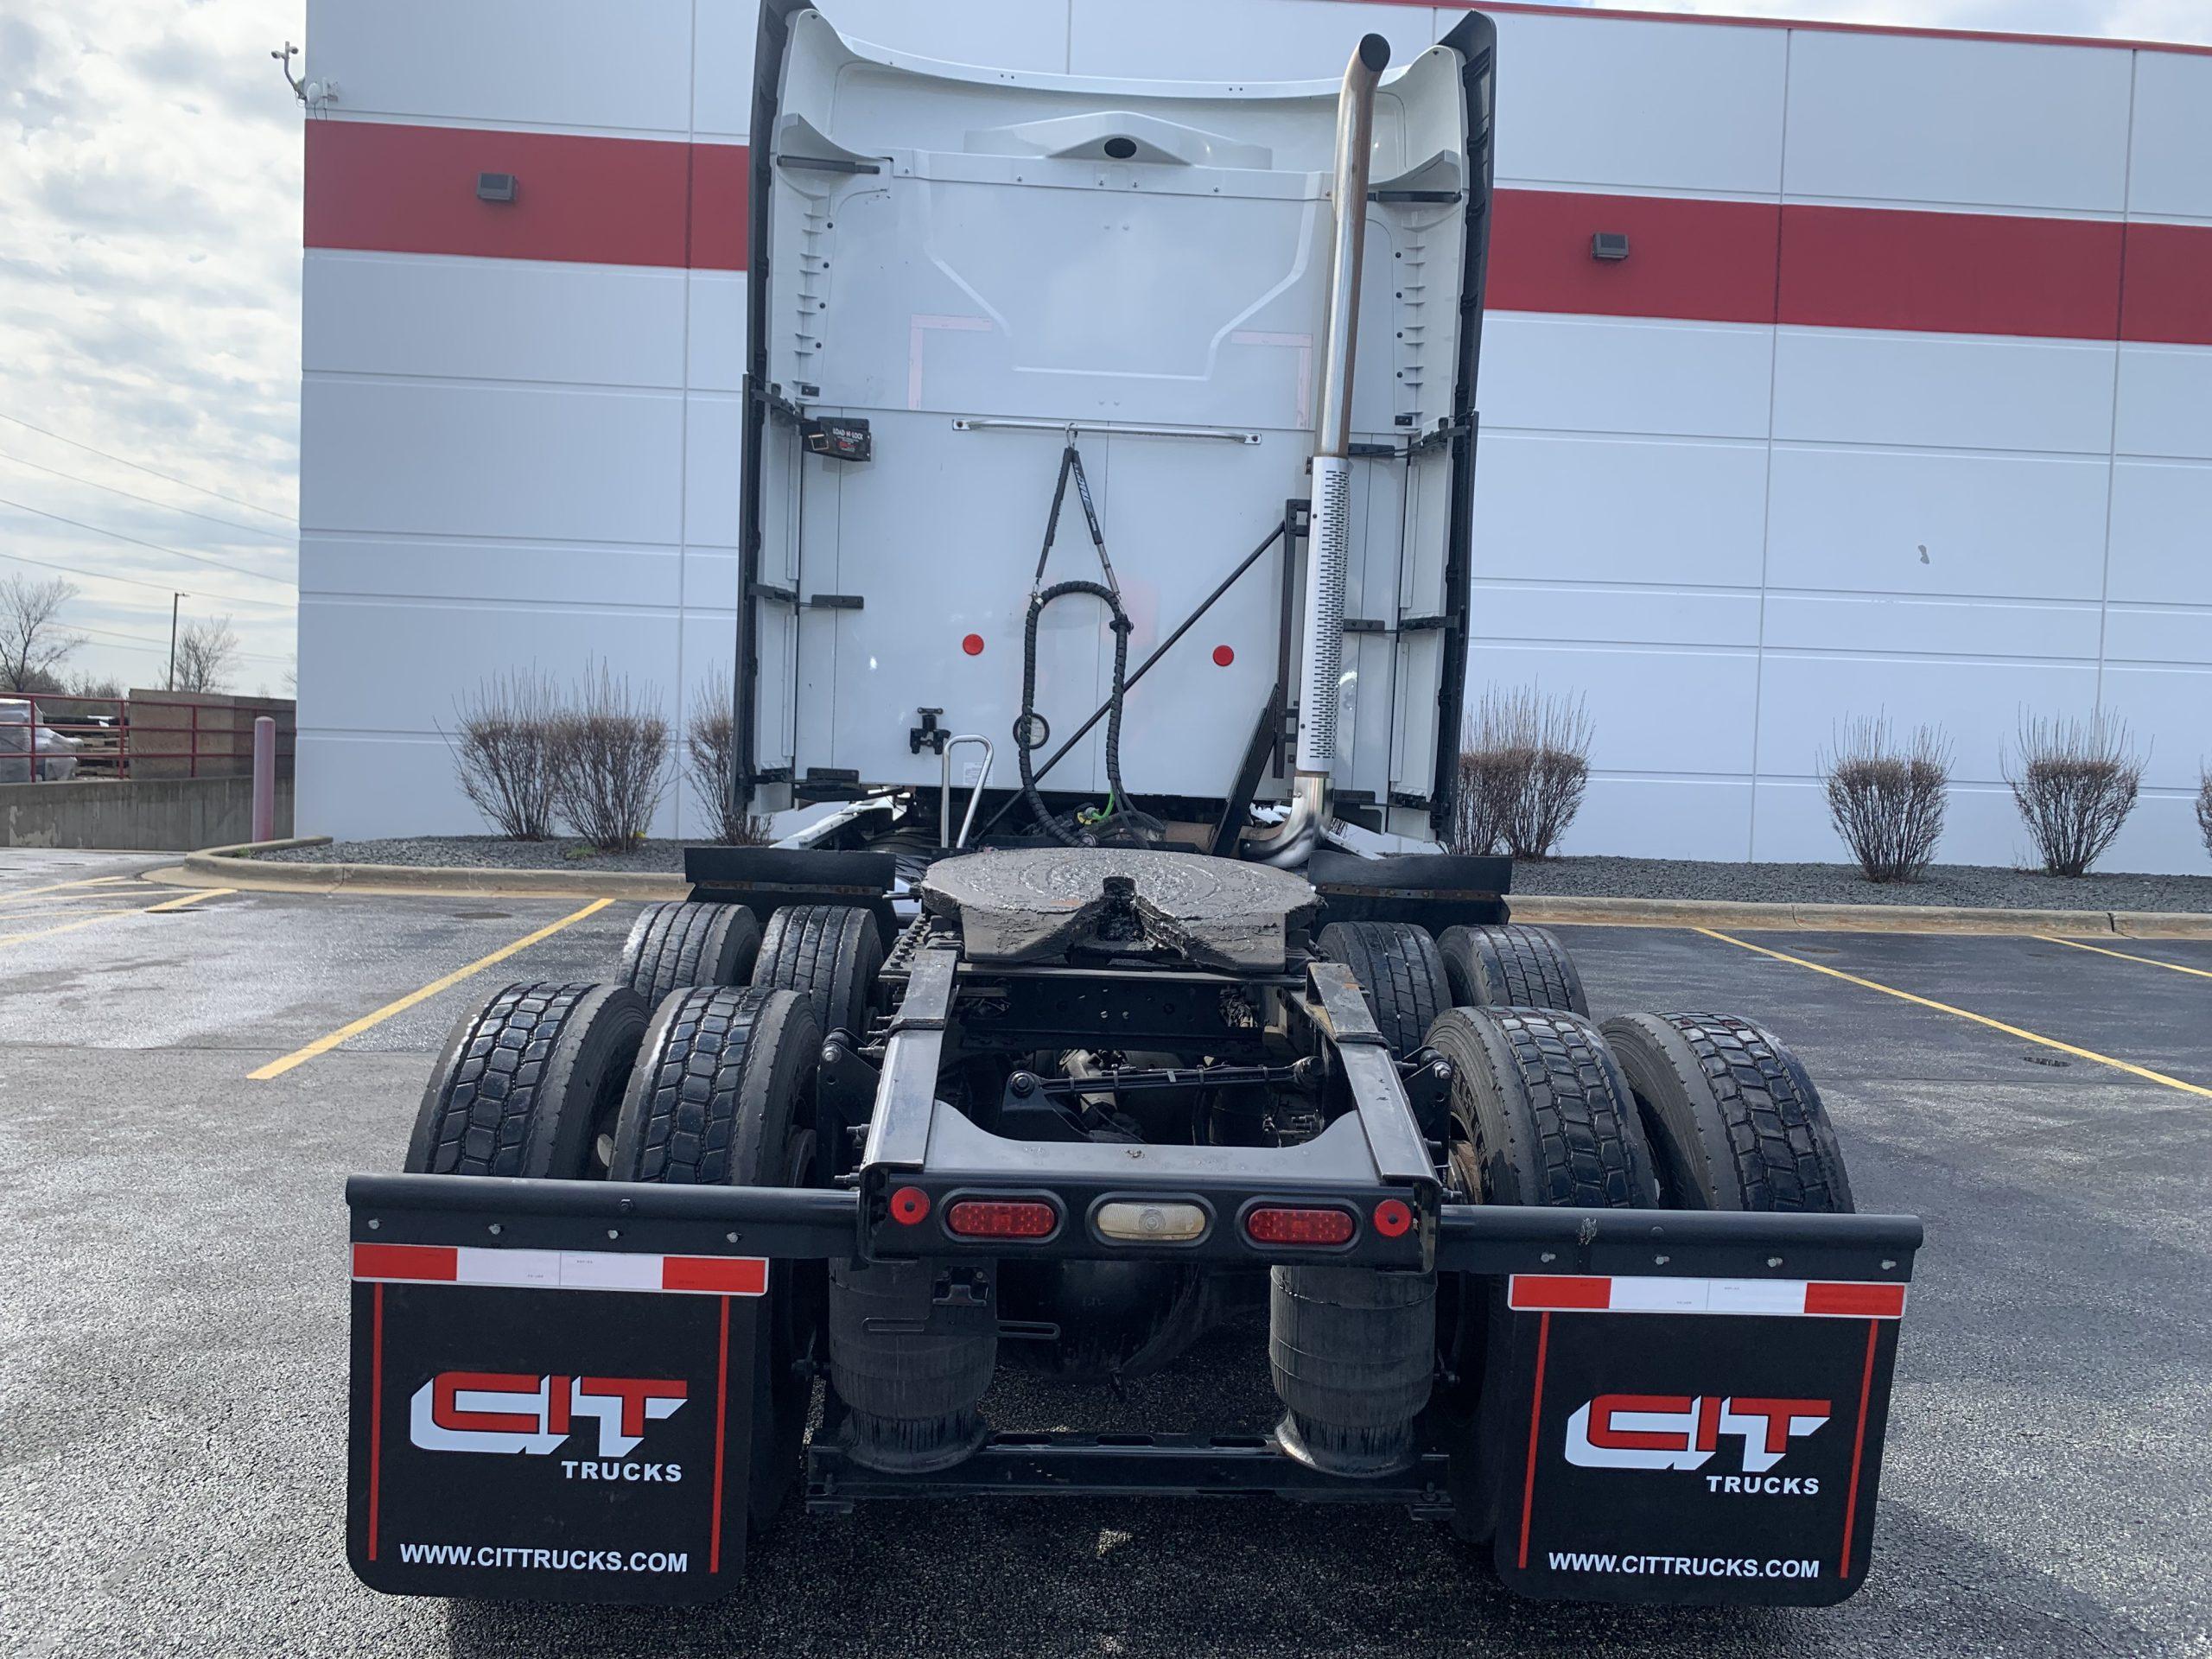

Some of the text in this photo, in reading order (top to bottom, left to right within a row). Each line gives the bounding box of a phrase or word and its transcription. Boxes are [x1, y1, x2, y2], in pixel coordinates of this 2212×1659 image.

[410, 1370, 688, 1458] CIT
[1565, 1394, 1832, 1472] CIT
[561, 1460, 682, 1482] TRUCKS
[1707, 1475, 1820, 1495] TRUCKS
[399, 1543, 689, 1573] WWW.CITTRUCKS.COM
[1548, 1552, 1820, 1578] WWW.CITTRUCKS.COM
